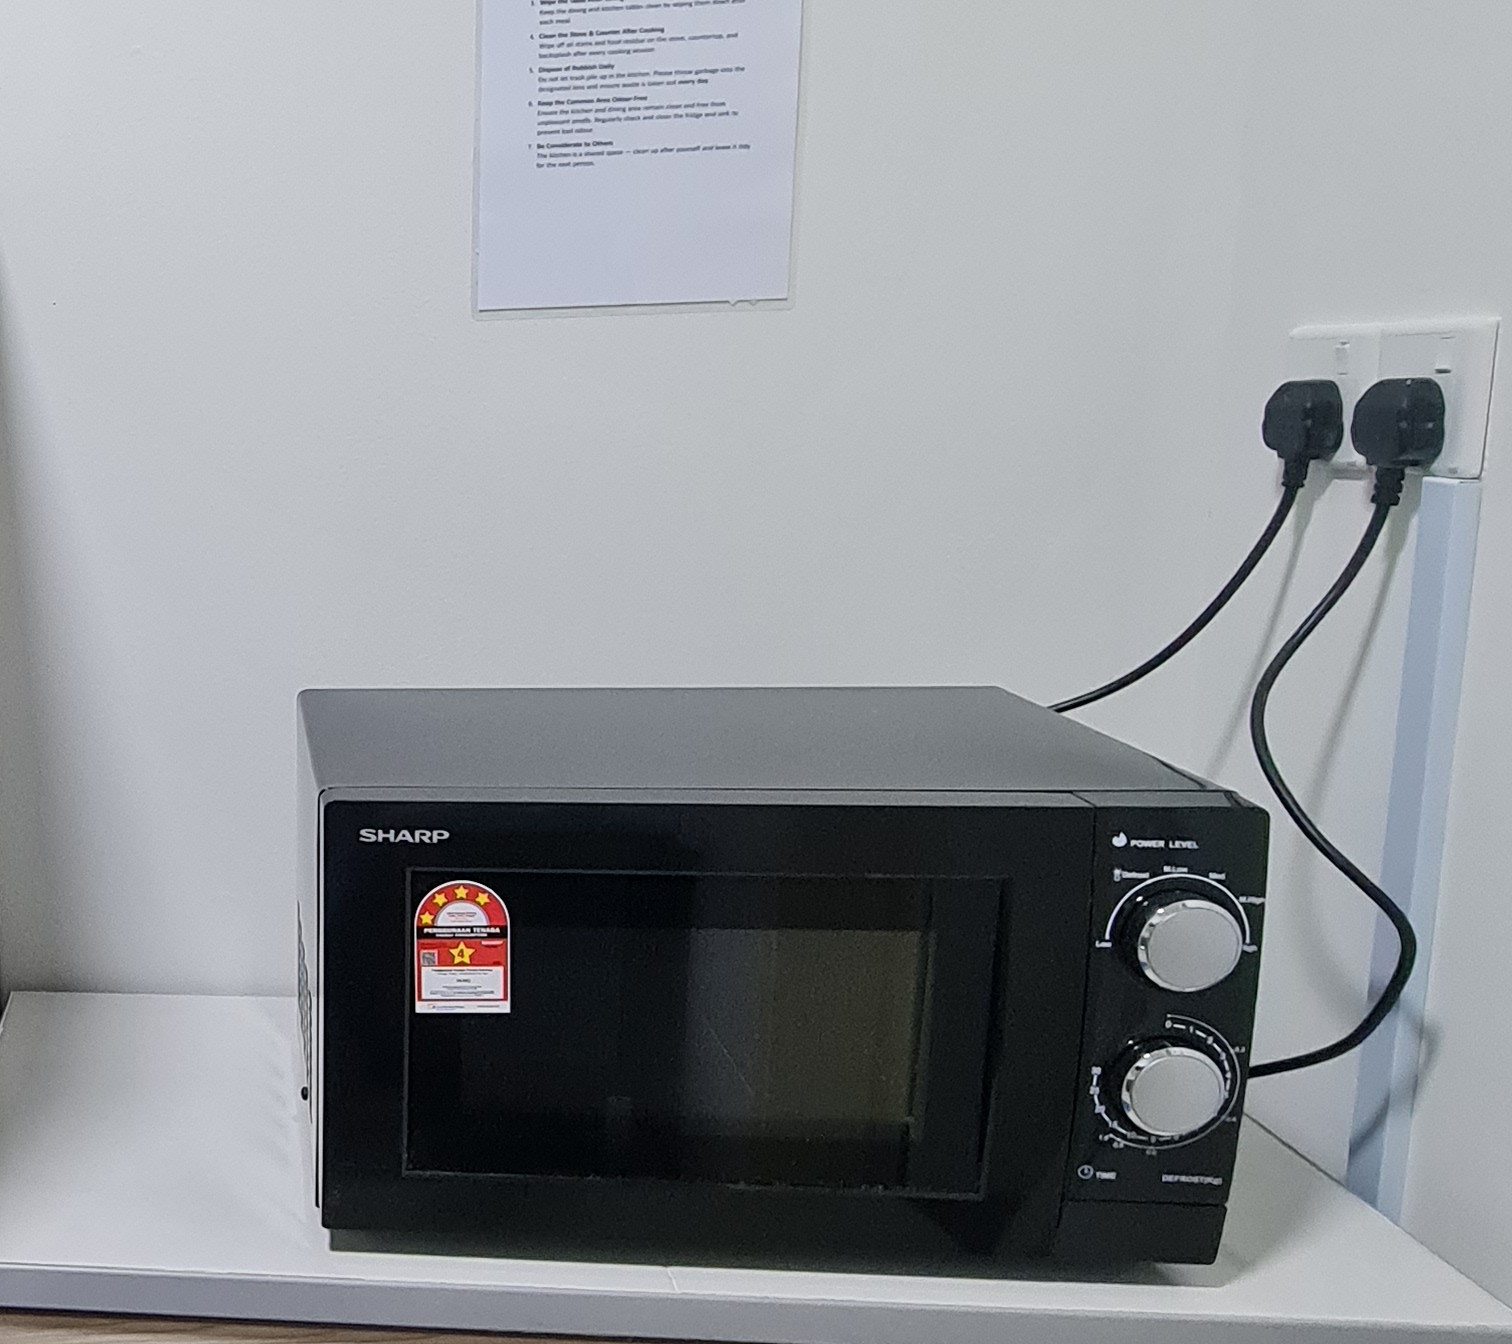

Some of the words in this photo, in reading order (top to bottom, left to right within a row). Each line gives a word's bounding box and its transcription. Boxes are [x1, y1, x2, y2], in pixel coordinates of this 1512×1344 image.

[359, 828, 450, 844] SHARP
[1130, 839, 1165, 848] POWER
[1168, 840, 1199, 849] LEVEL
[457, 948, 465, 959] 4
